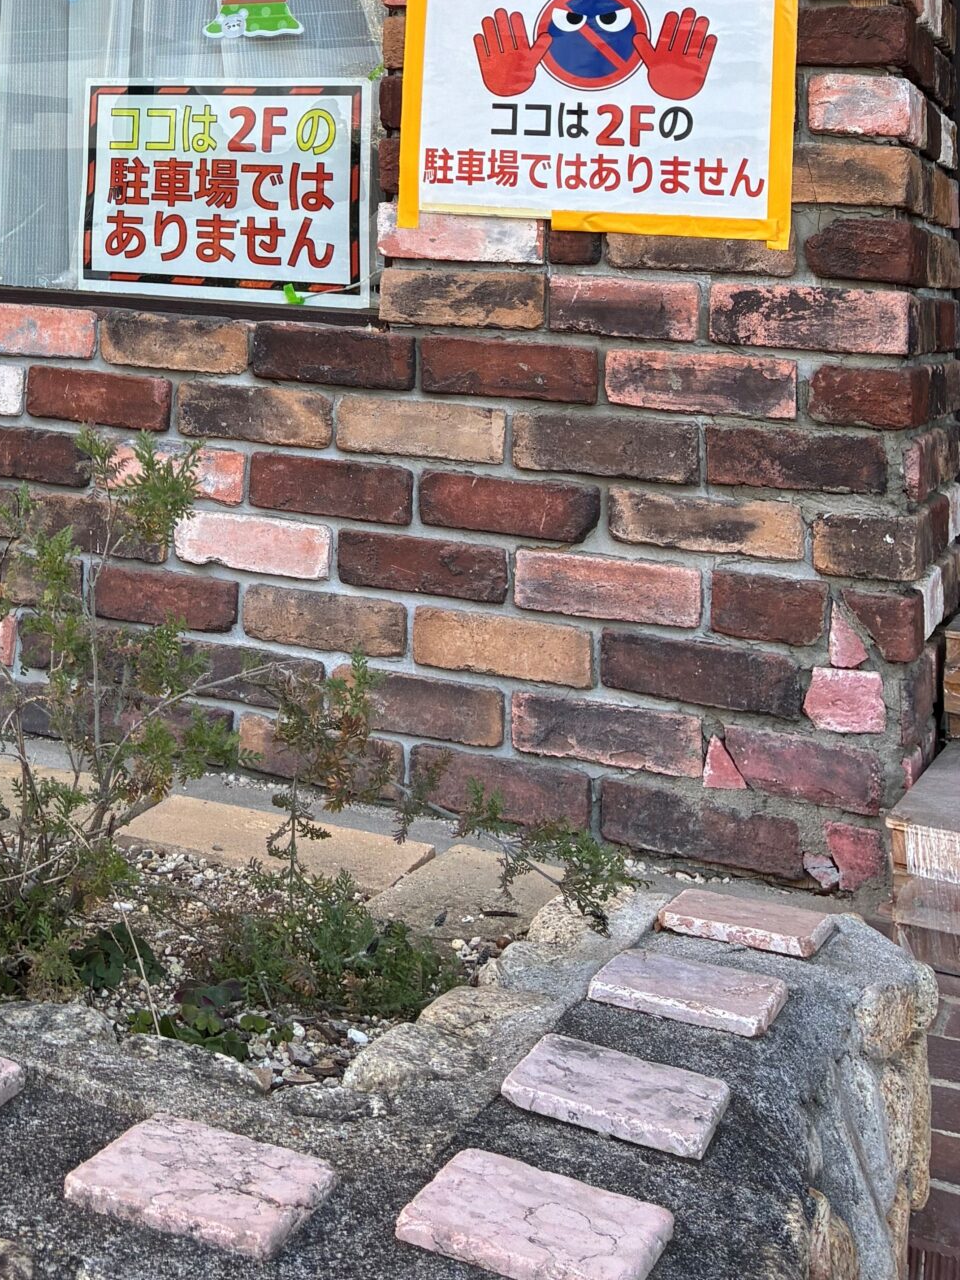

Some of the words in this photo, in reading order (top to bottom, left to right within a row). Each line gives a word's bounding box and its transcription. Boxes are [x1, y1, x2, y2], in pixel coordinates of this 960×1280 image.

[109, 104, 337, 156] ココは2Fの
[490, 101, 693, 147] ココは2Fの
[106, 157, 335, 212] 駐車場では
[423, 147, 766, 198] 駐車場ではありません
[104, 210, 335, 269] ありません
